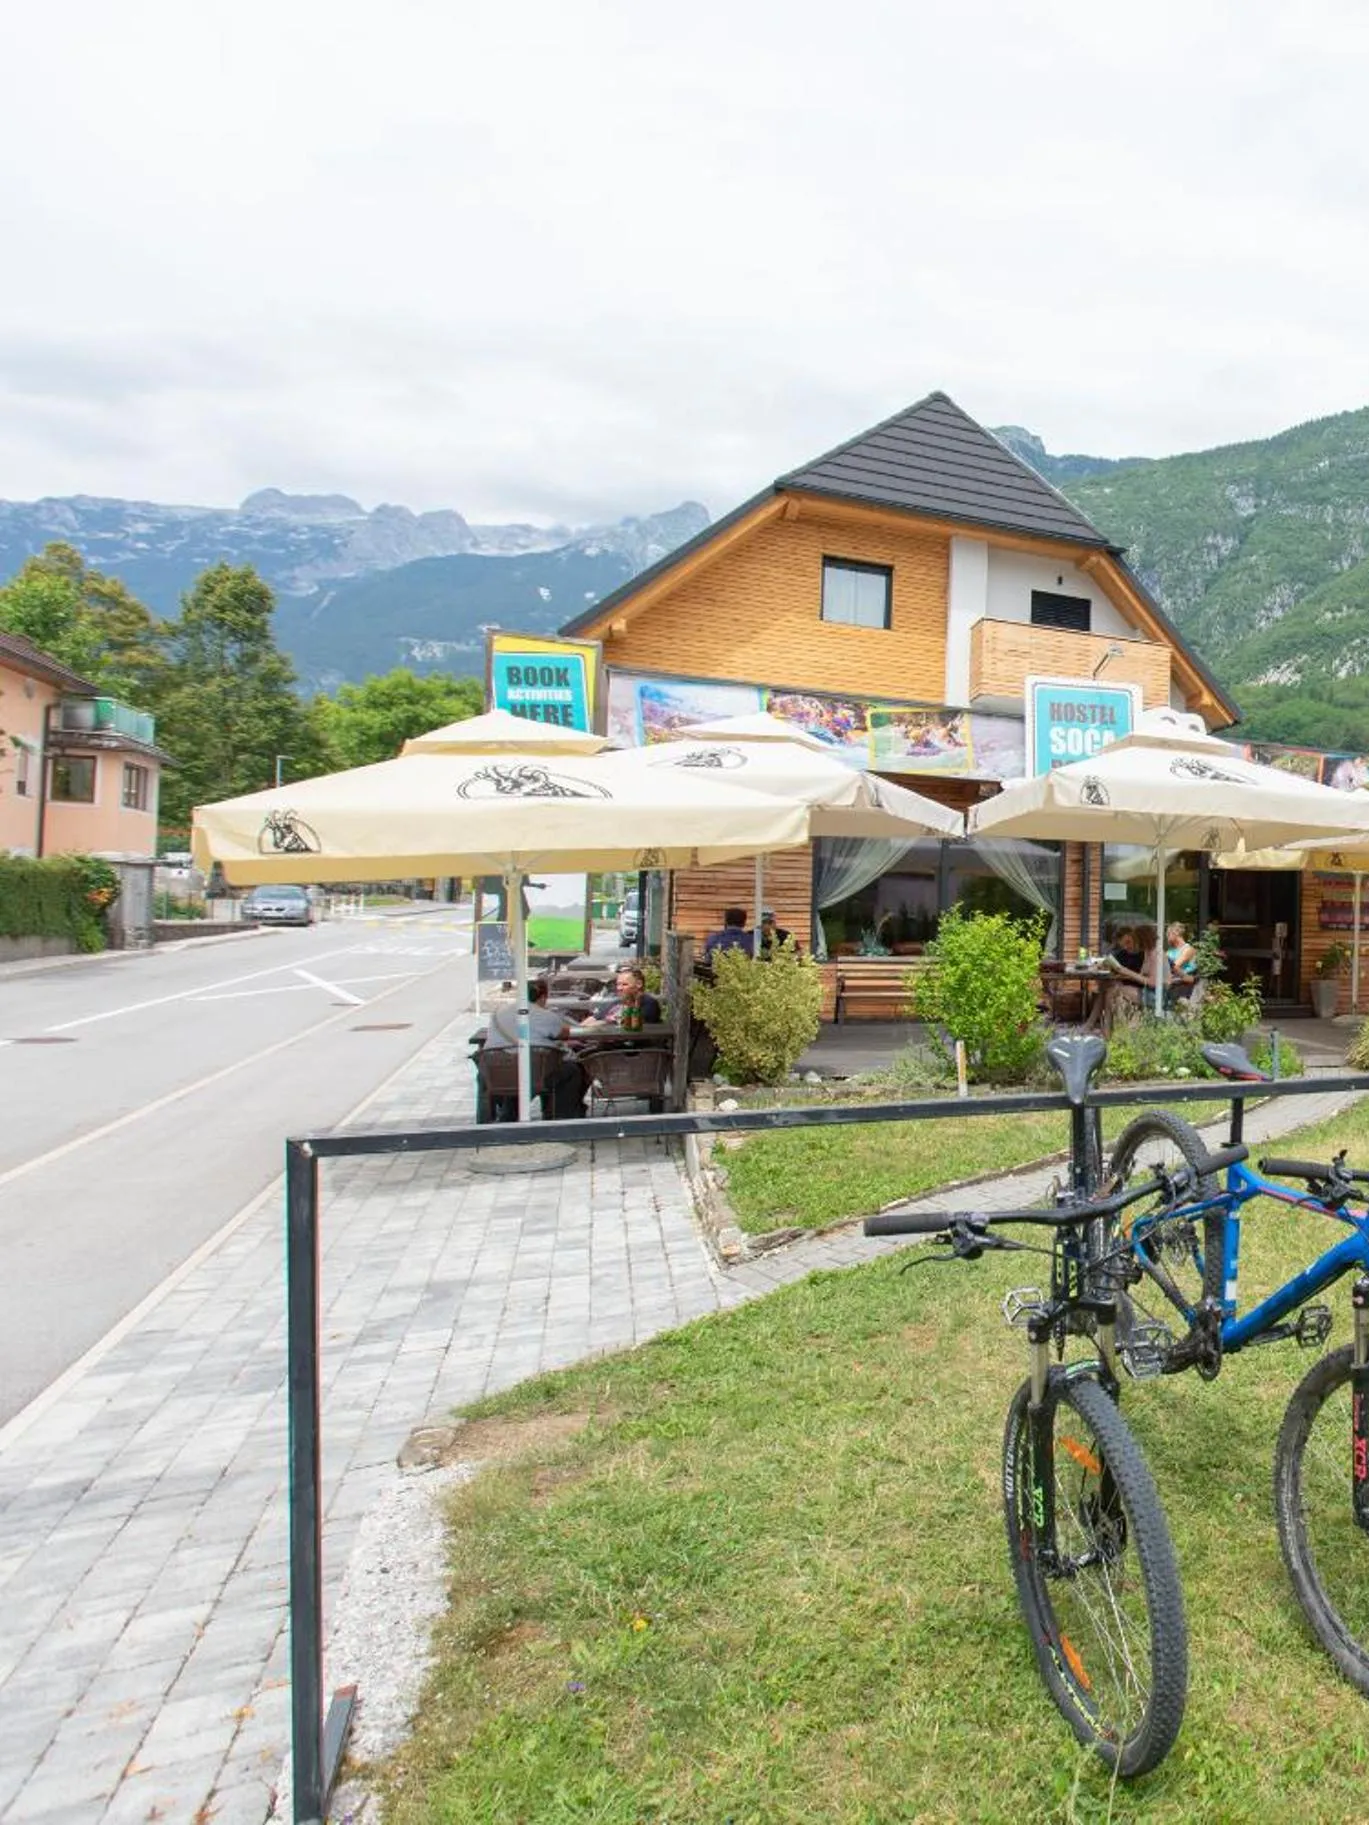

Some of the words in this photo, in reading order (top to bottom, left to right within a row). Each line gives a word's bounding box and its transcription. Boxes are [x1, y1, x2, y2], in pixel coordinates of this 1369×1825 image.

[507, 667, 570, 686] BOOK
[507, 688, 572, 701] ACTIVITIES
[510, 703, 574, 728] HERE
[1050, 702, 1117, 724] HOSTEL
